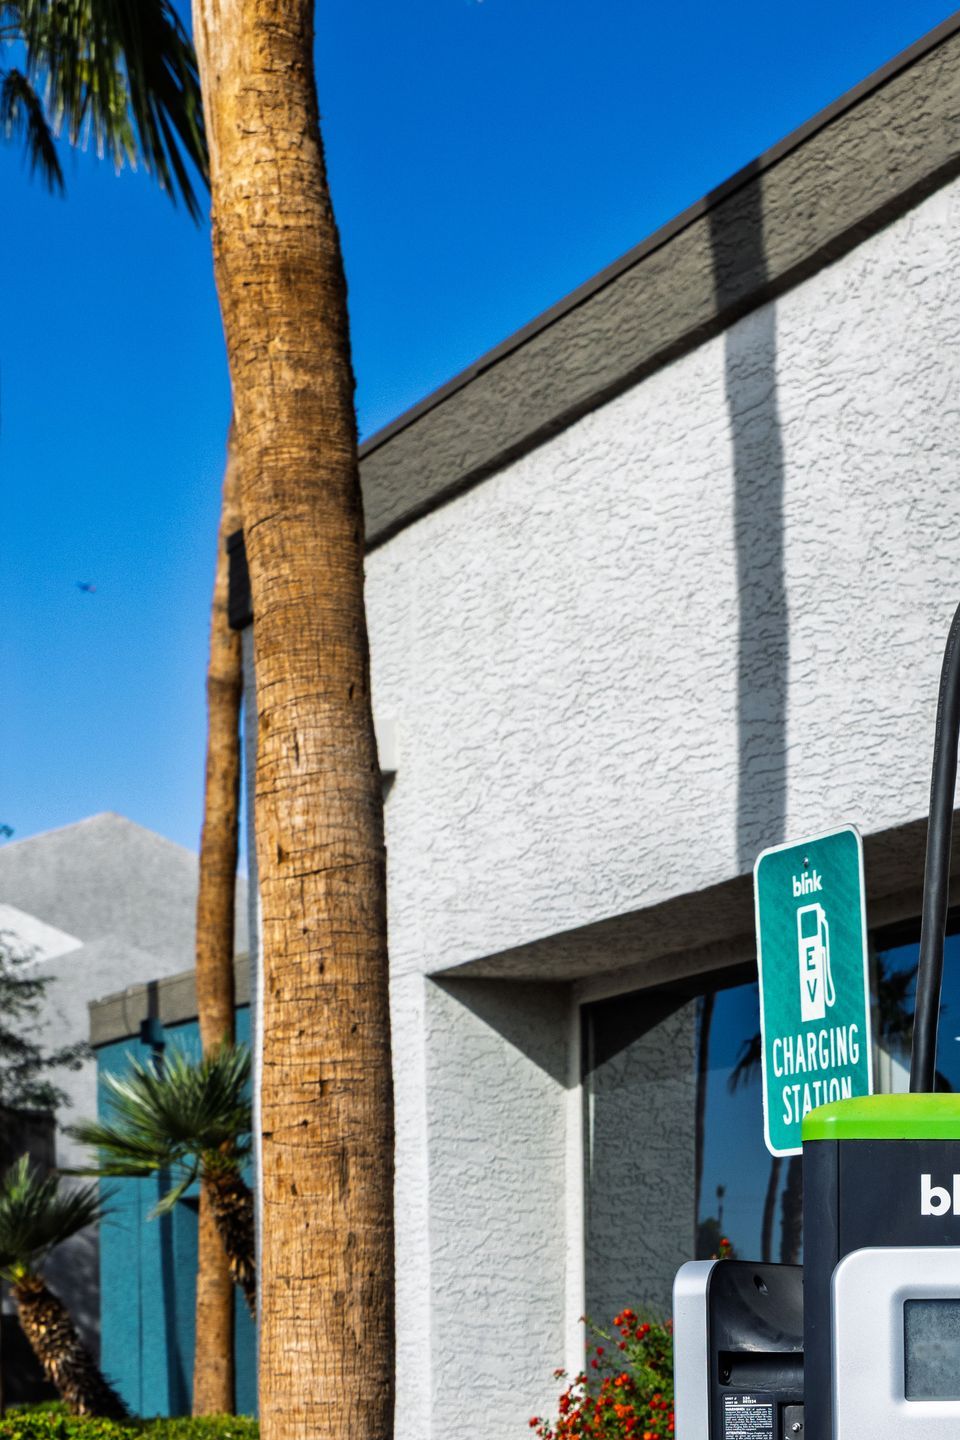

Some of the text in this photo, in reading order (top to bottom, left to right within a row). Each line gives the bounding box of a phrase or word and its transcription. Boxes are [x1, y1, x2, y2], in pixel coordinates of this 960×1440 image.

[792, 869, 823, 897] blink
[773, 1024, 859, 1078] CHARGING
[782, 1076, 852, 1125] STATION
